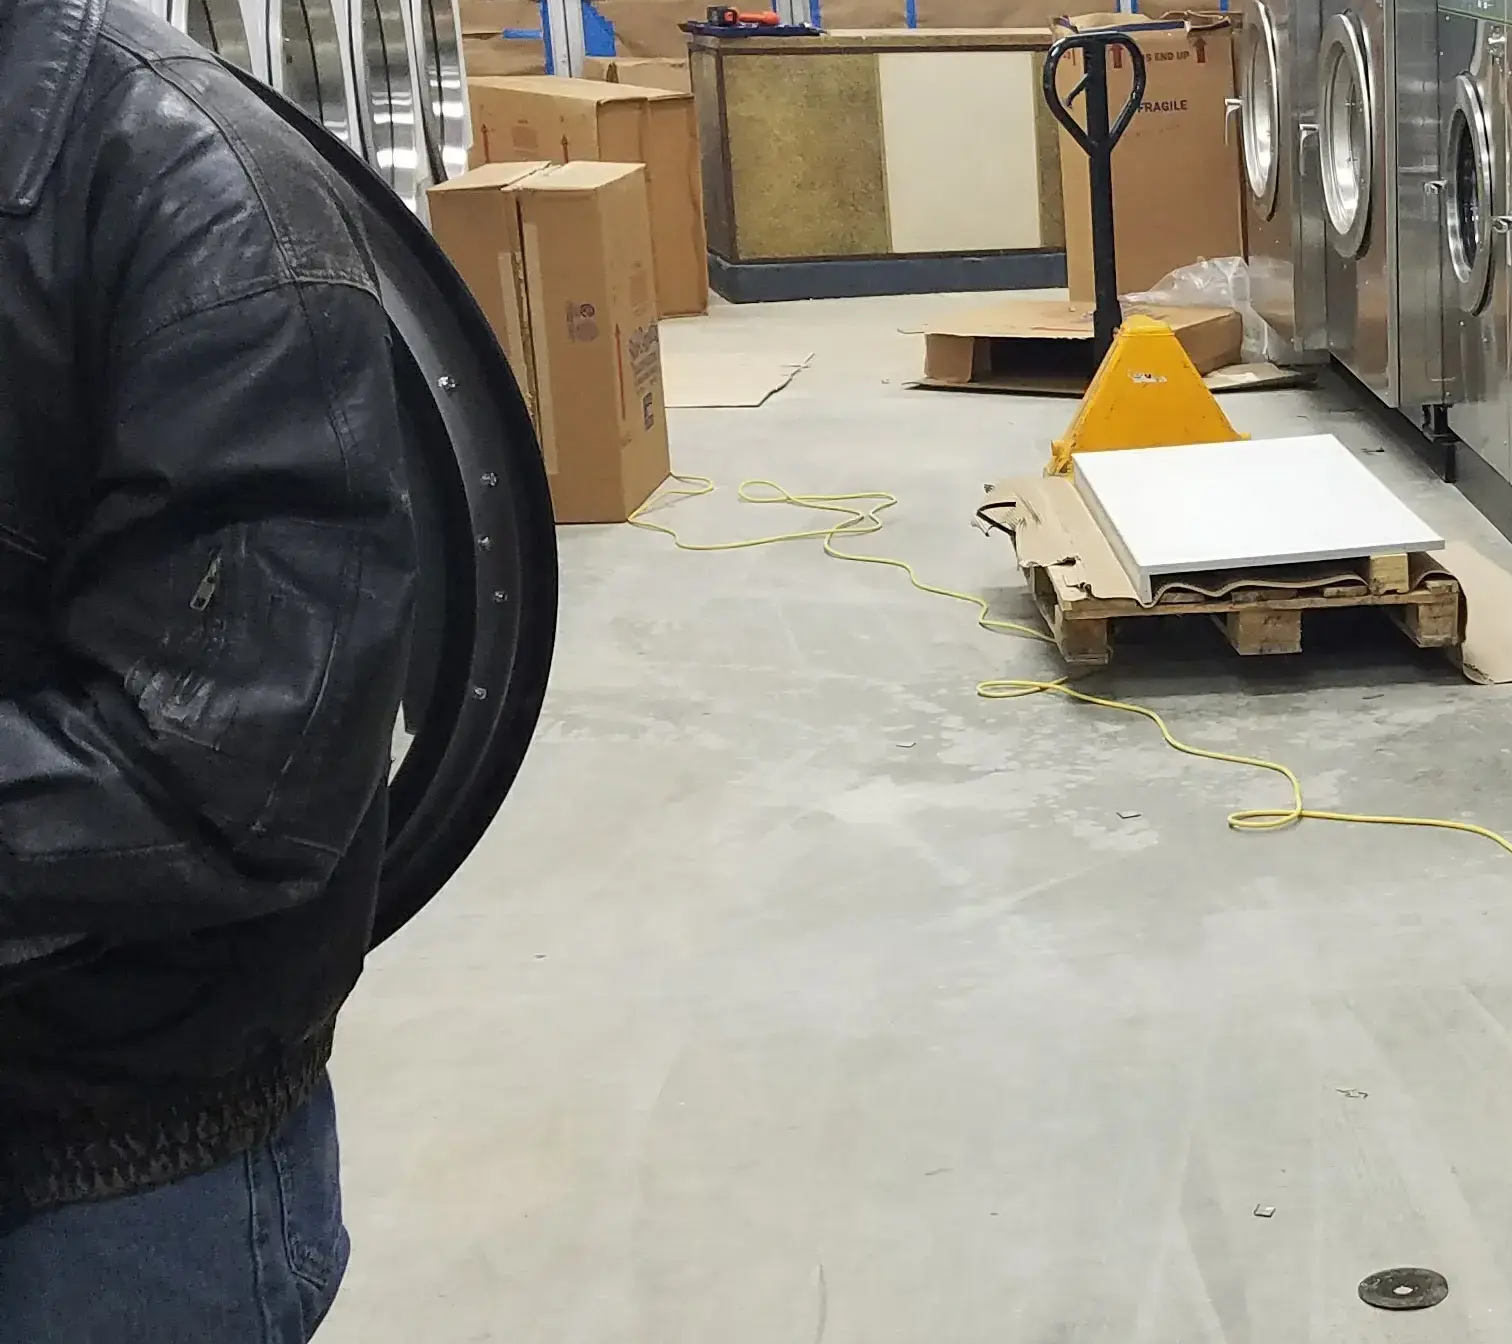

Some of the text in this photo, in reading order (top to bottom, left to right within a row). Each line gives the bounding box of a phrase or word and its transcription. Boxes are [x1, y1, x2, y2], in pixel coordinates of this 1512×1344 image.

[1155, 52, 1174, 61] END
[1177, 51, 1190, 60] UP
[1138, 100, 1187, 113] FRAGILE
